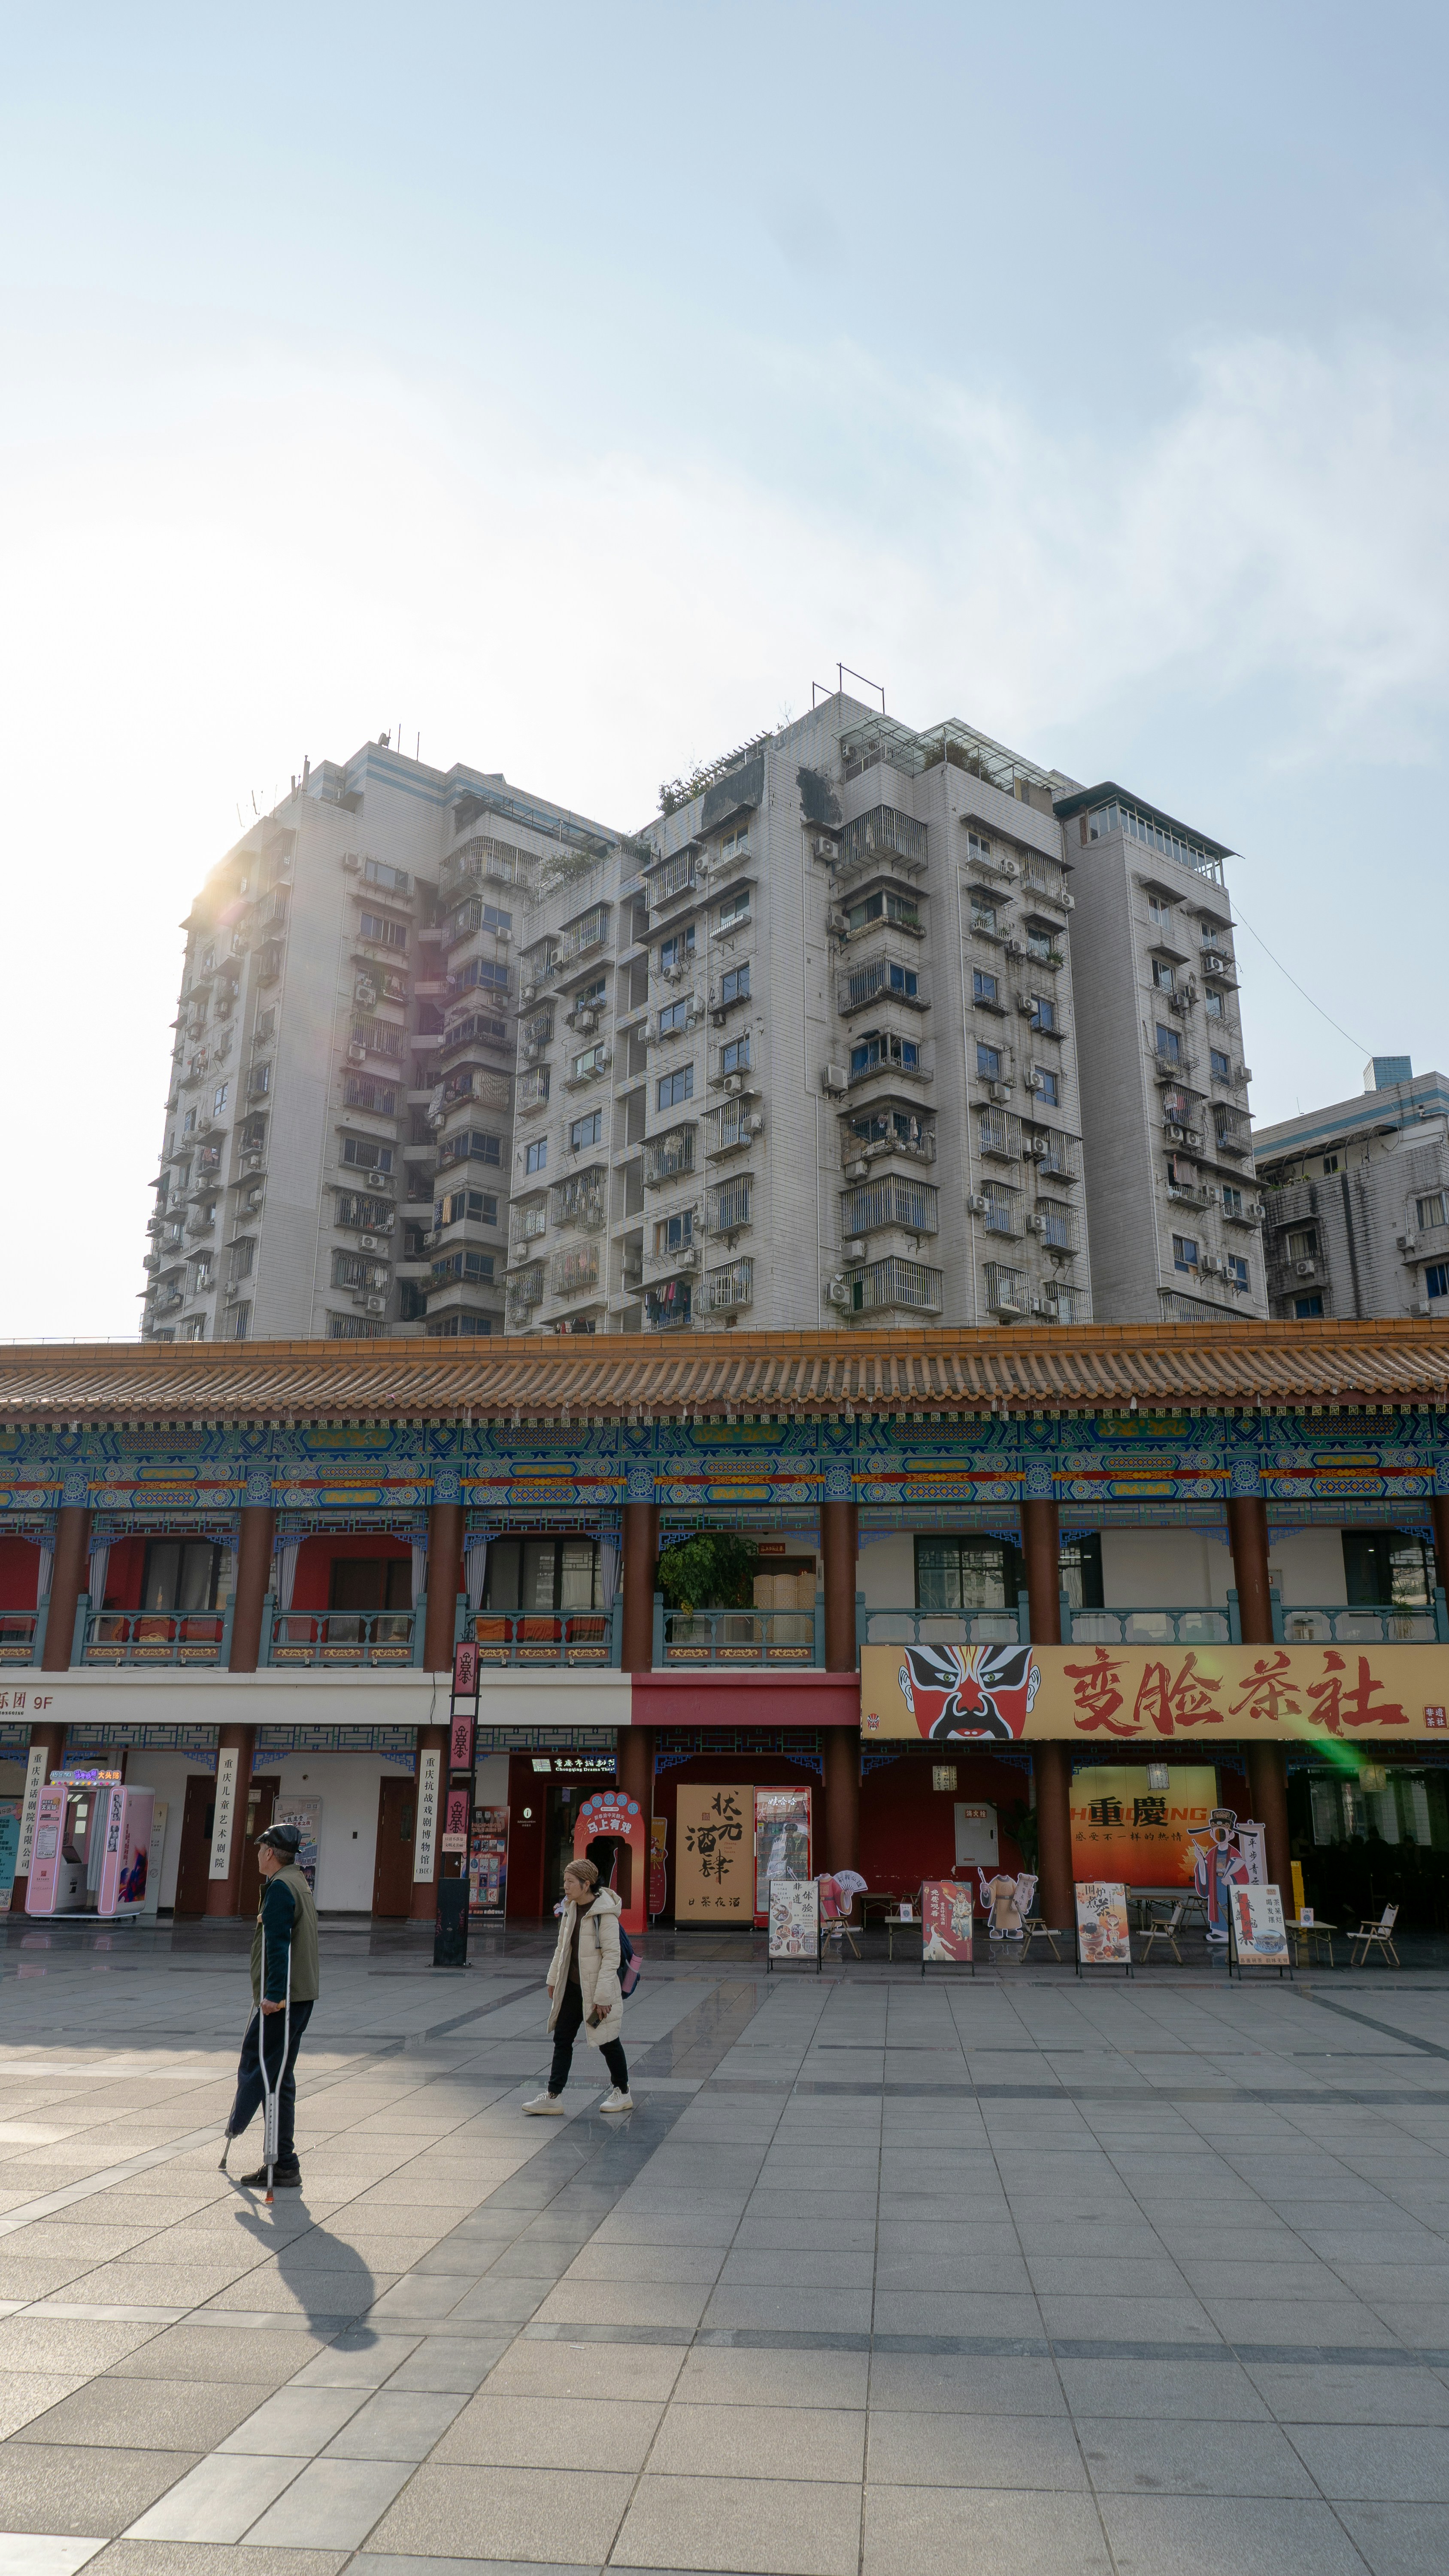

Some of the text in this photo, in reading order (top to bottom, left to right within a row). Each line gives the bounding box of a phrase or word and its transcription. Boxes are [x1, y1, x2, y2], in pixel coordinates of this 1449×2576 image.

[34, 1697, 53, 1709] 9F
[1064, 1646, 1410, 1737] 变脸茶社
[1426, 1717, 1446, 1726] 茶社
[98, 1771, 120, 1780] 大头贴
[21, 1754, 42, 1869] 重庆市话剧院有限公司
[215, 1759, 233, 1868] 重庆儿童艺术剧院
[420, 1758, 435, 1865] 重庆抗战戏剧博物馆
[767, 1796, 797, 1806] 娃哈哈
[1088, 1796, 1169, 1826] 重慶
[587, 1819, 632, 1834] 马上有戏
[1076, 1832, 1183, 1841] 感受不一样的热情
[1248, 1838, 1259, 1885] 平步青云
[931, 1889, 940, 1917] 免费观看
